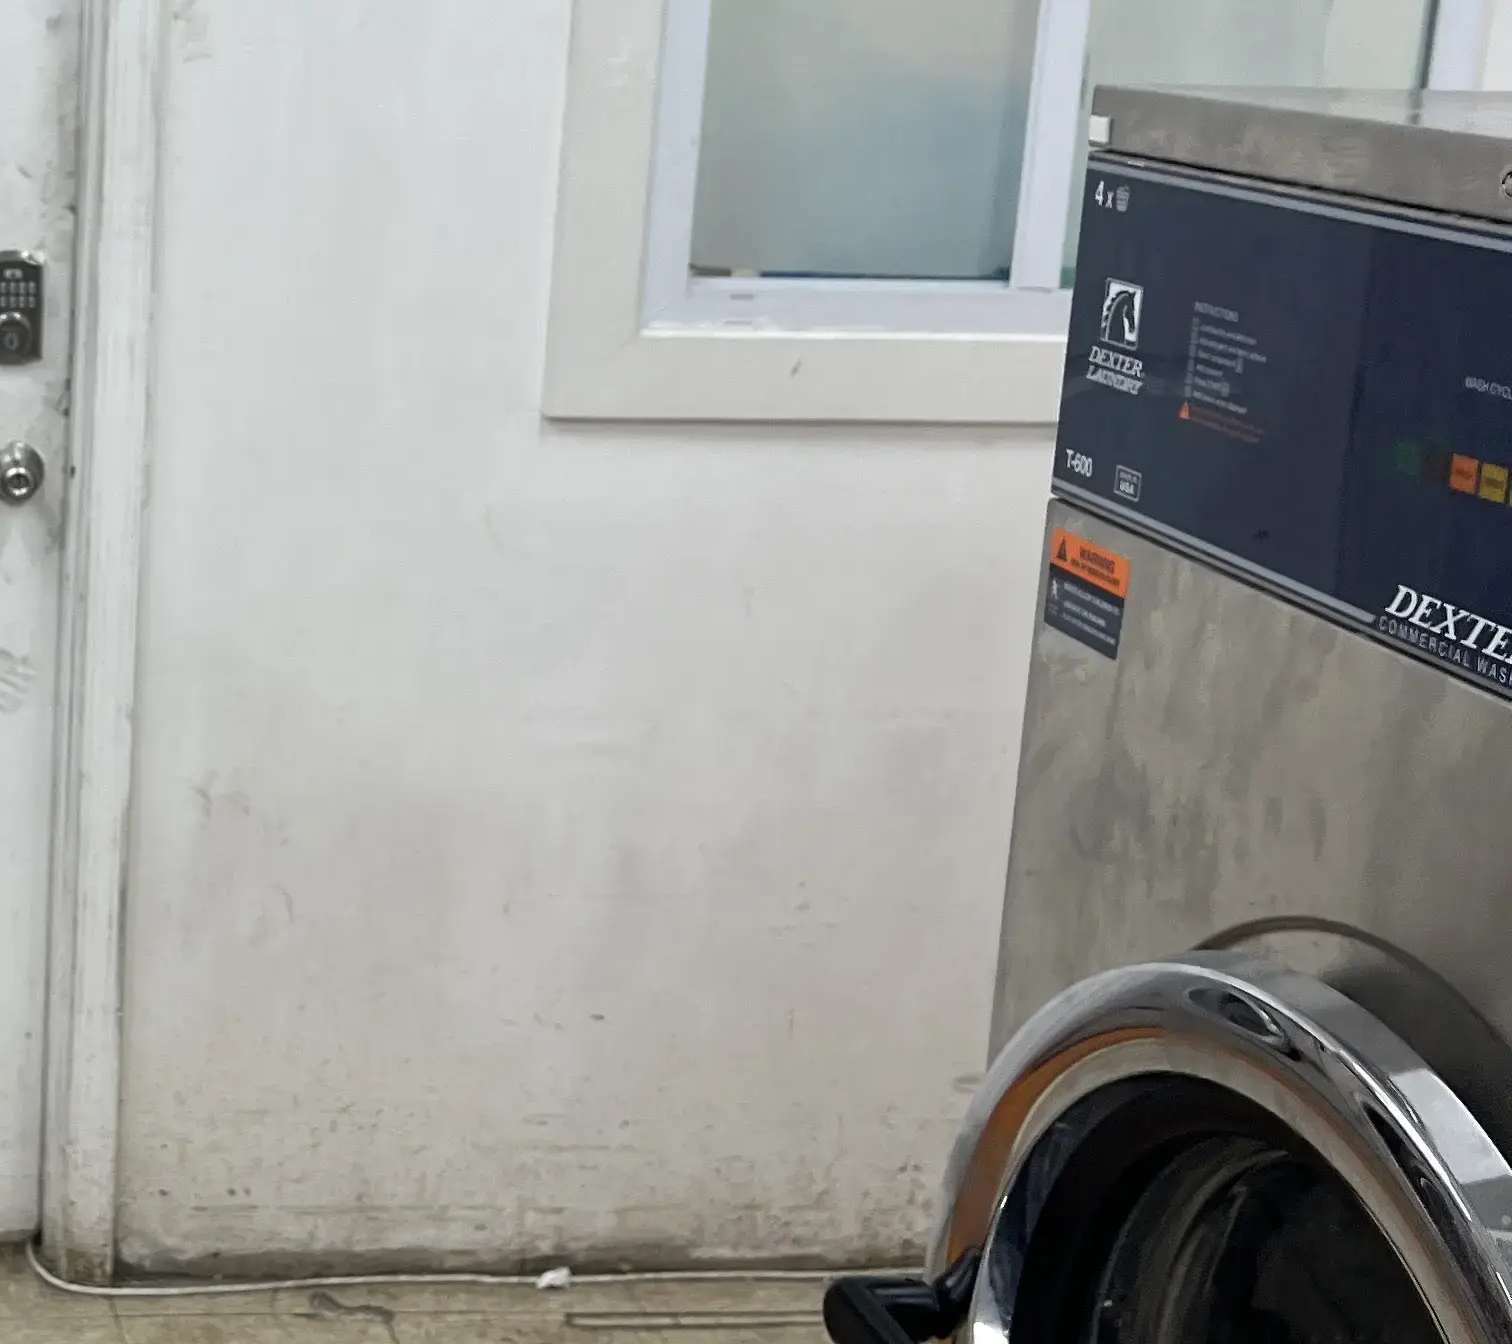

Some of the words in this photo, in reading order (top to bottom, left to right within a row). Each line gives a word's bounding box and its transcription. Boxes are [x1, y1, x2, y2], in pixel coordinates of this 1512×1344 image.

[1088, 345, 1144, 378] DEXTER
[1378, 615, 1471, 668] COMMERCIAL
[1385, 584, 1512, 666] DEXTE
